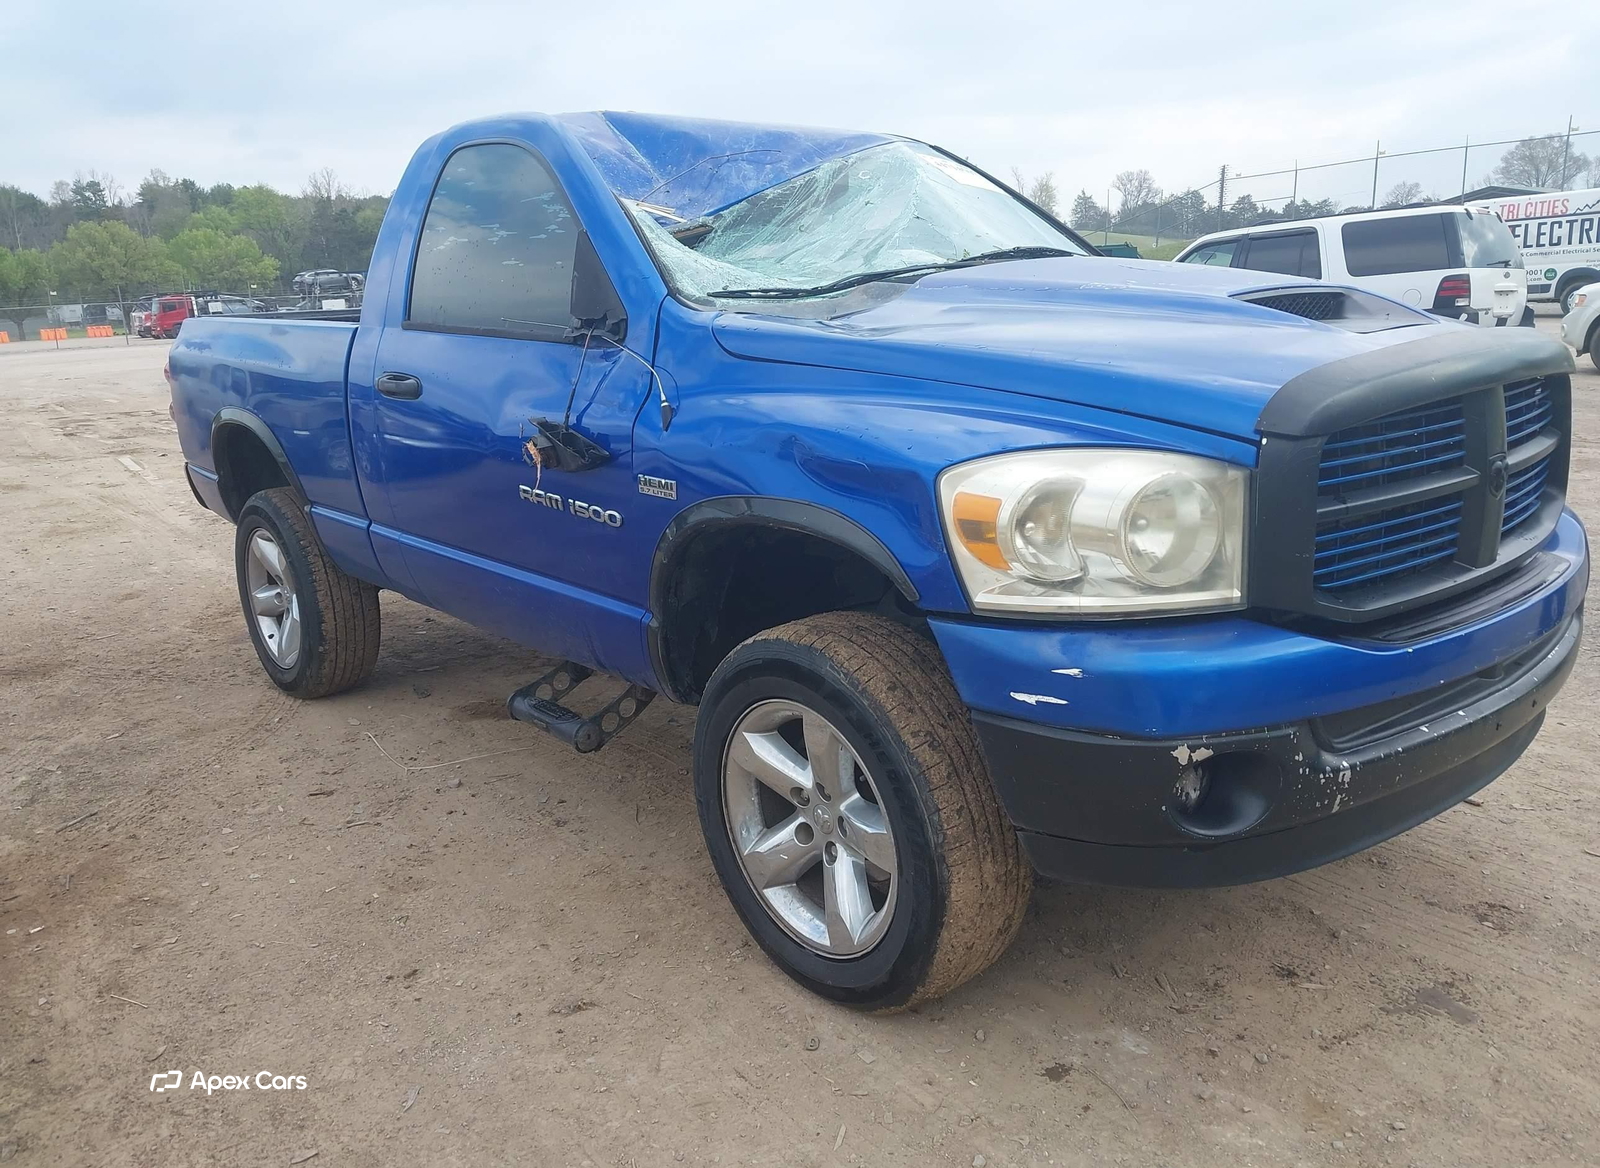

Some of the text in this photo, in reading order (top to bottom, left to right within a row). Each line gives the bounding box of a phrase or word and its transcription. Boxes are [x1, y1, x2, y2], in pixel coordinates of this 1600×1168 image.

[1500, 199, 1569, 219] TRI CITIES
[1525, 249, 1561, 257] Commercial
[1562, 246, 1591, 254] Electrical
[638, 476, 675, 491] HEMI
[652, 488, 674, 498] LITER
[518, 484, 624, 528] RAM 1500
